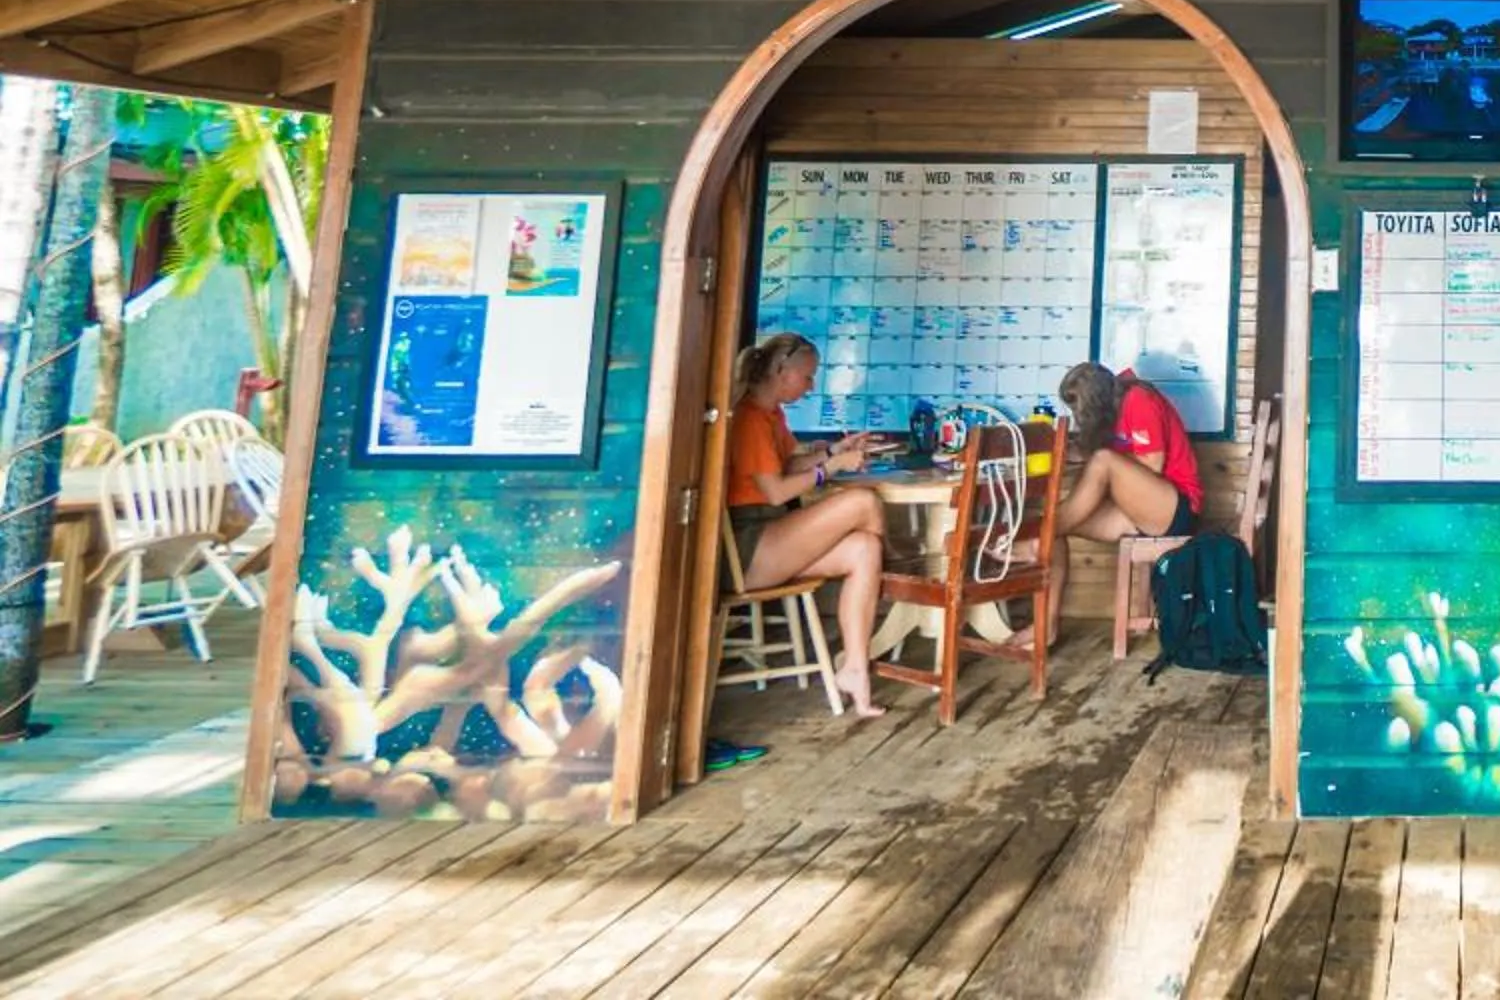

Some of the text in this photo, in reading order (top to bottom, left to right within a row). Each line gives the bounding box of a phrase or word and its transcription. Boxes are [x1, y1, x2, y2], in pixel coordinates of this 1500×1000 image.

[801, 169, 1072, 185] SUN MON TUE WED THUR FRI SAT
[1375, 213, 1435, 233] TOYITA
[1451, 214, 1500, 233] SOFIA
